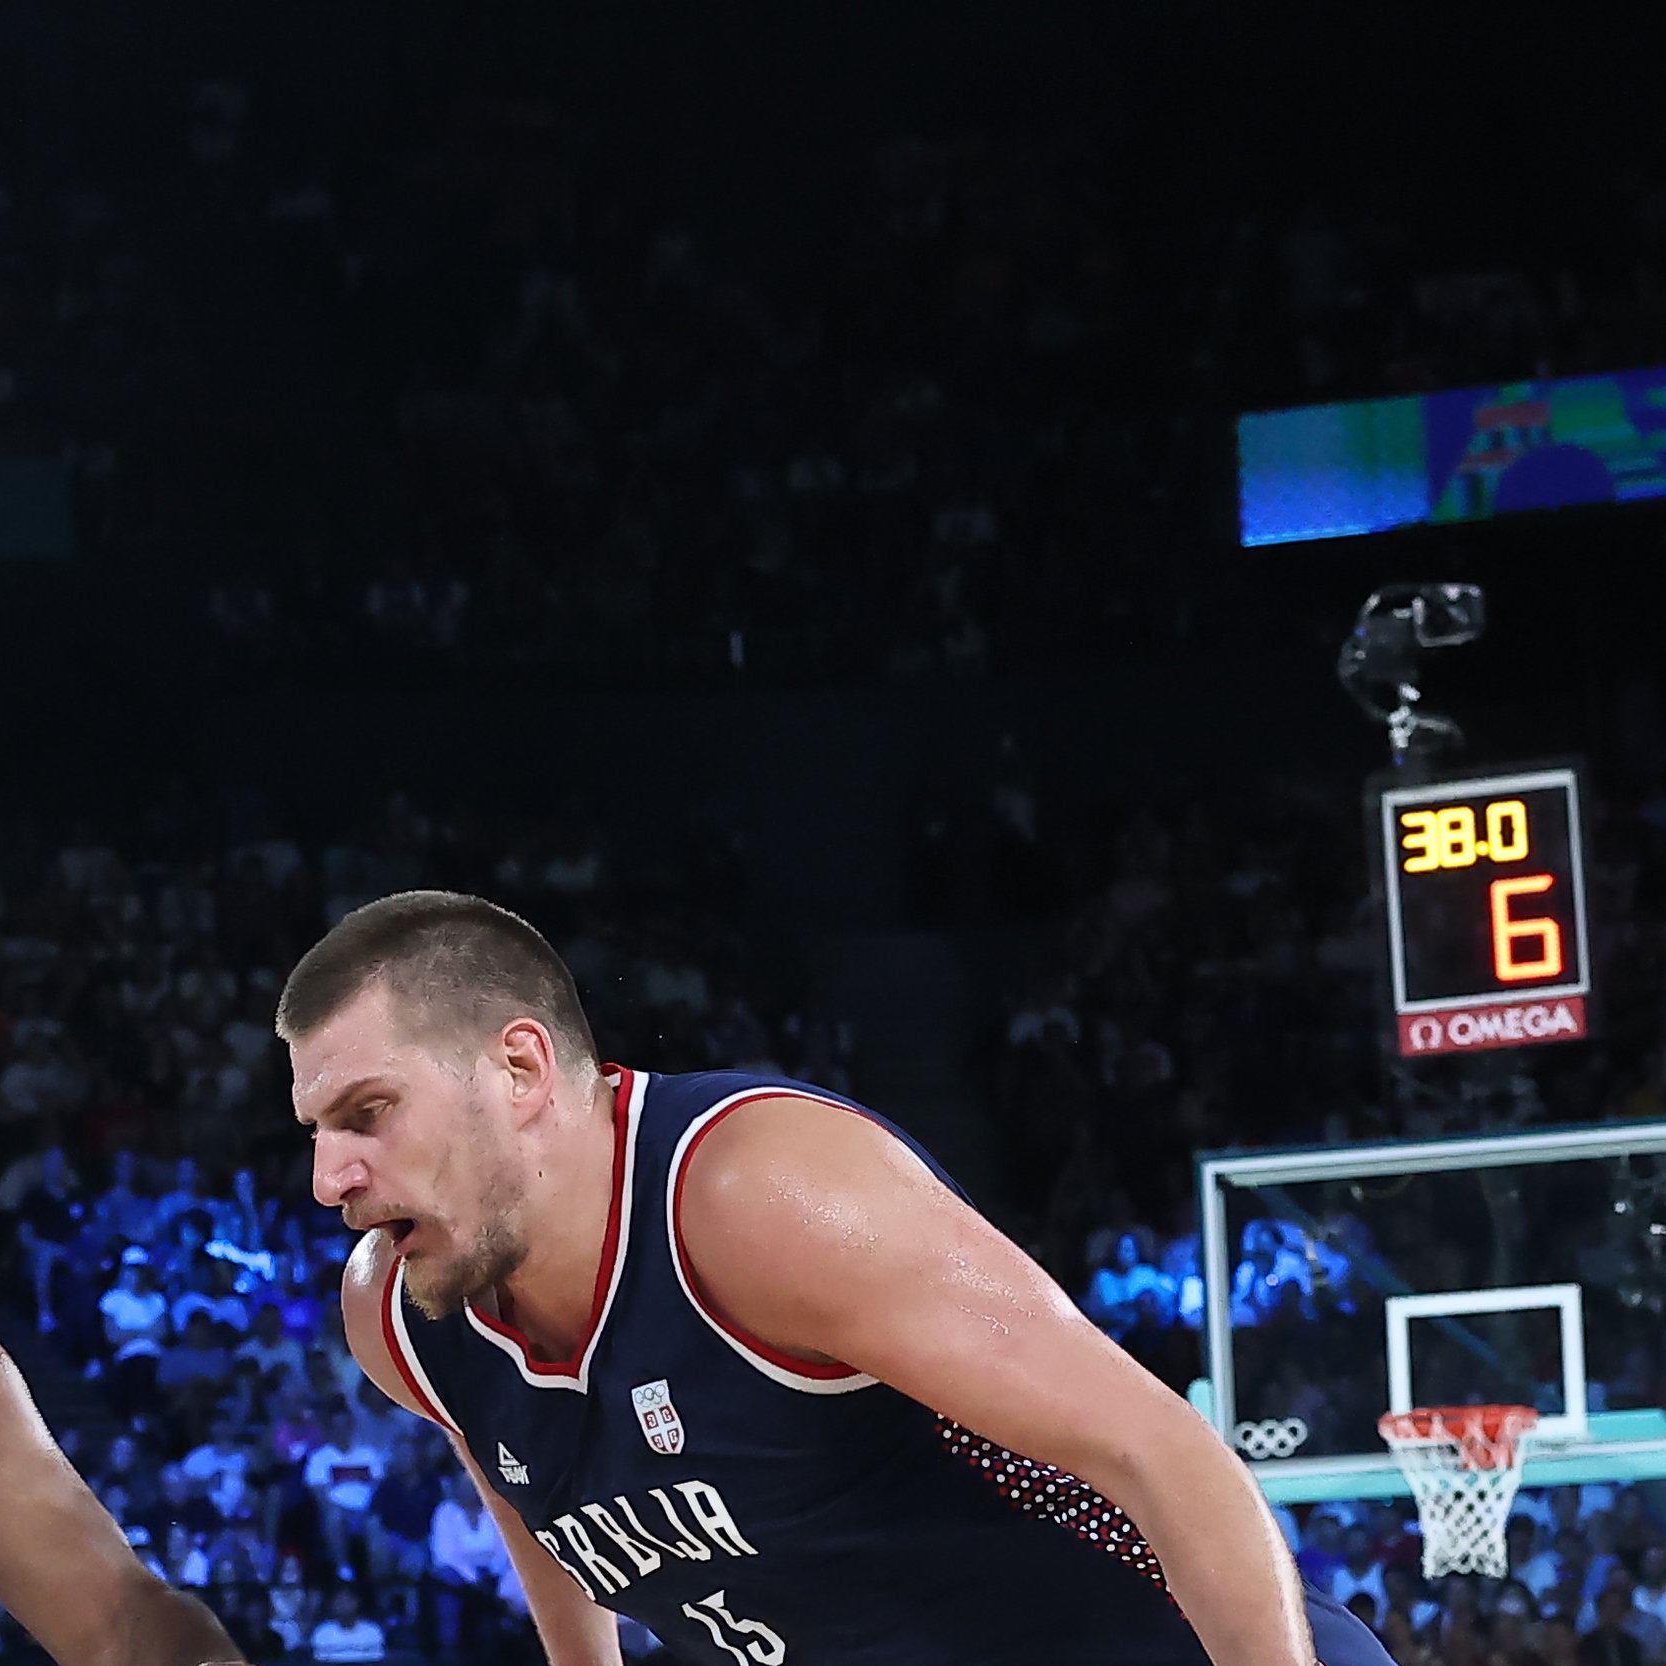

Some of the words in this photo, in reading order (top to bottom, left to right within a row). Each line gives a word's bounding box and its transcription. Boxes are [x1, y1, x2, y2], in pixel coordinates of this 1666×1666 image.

[1401, 800, 1529, 873] 38.0
[1489, 874, 1562, 982] 6
[1448, 1003, 1578, 1046] OMEGA
[535, 1480, 759, 1601] SRBIJA
